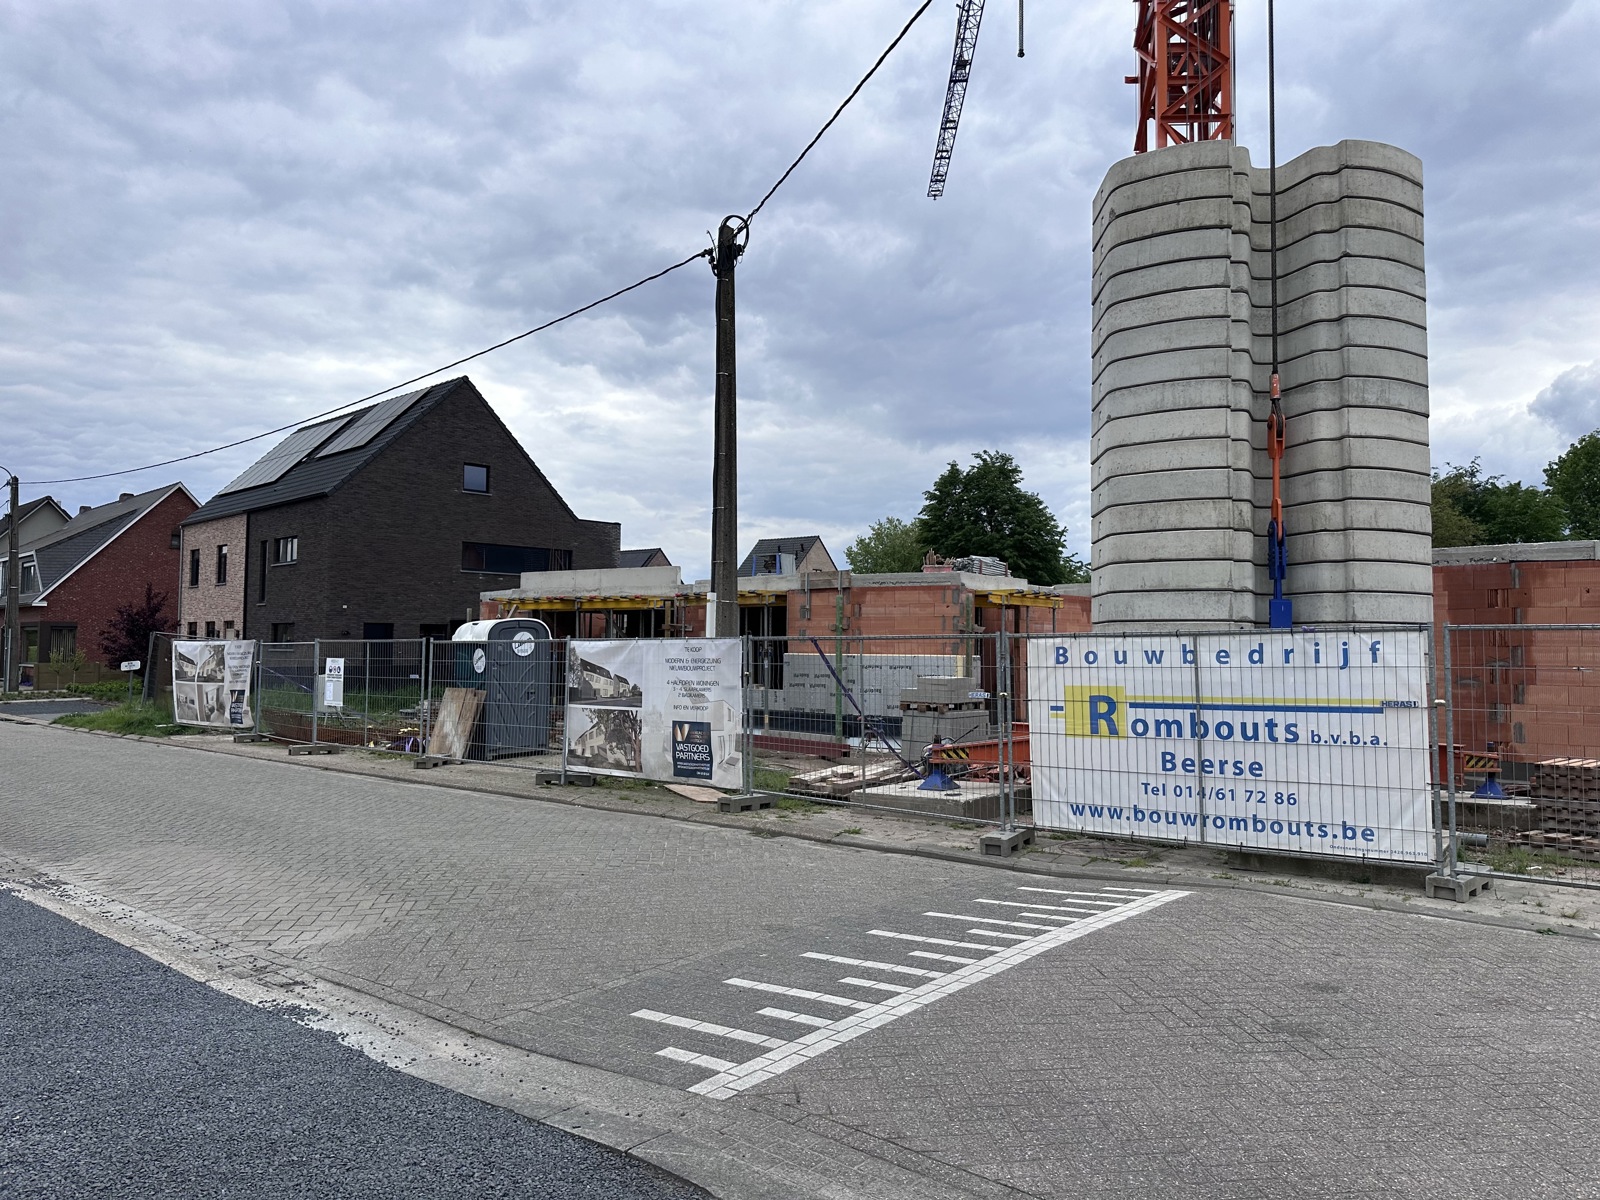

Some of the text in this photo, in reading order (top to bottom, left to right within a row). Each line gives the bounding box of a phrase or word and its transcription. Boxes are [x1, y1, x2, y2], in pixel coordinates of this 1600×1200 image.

[1055, 641, 1381, 670] Bouwbedrijf
[1381, 700, 1413, 708] HERAS
[1088, 695, 1388, 746] Rombouts b.v.b.a.
[675, 743, 709, 752] VASTGOED
[675, 751, 710, 761] PARTNERS
[1161, 751, 1264, 777] Beerse
[1141, 782, 1297, 806] Tel 014/61 72 86
[1070, 804, 1375, 842] www.bouwrombouts.be
